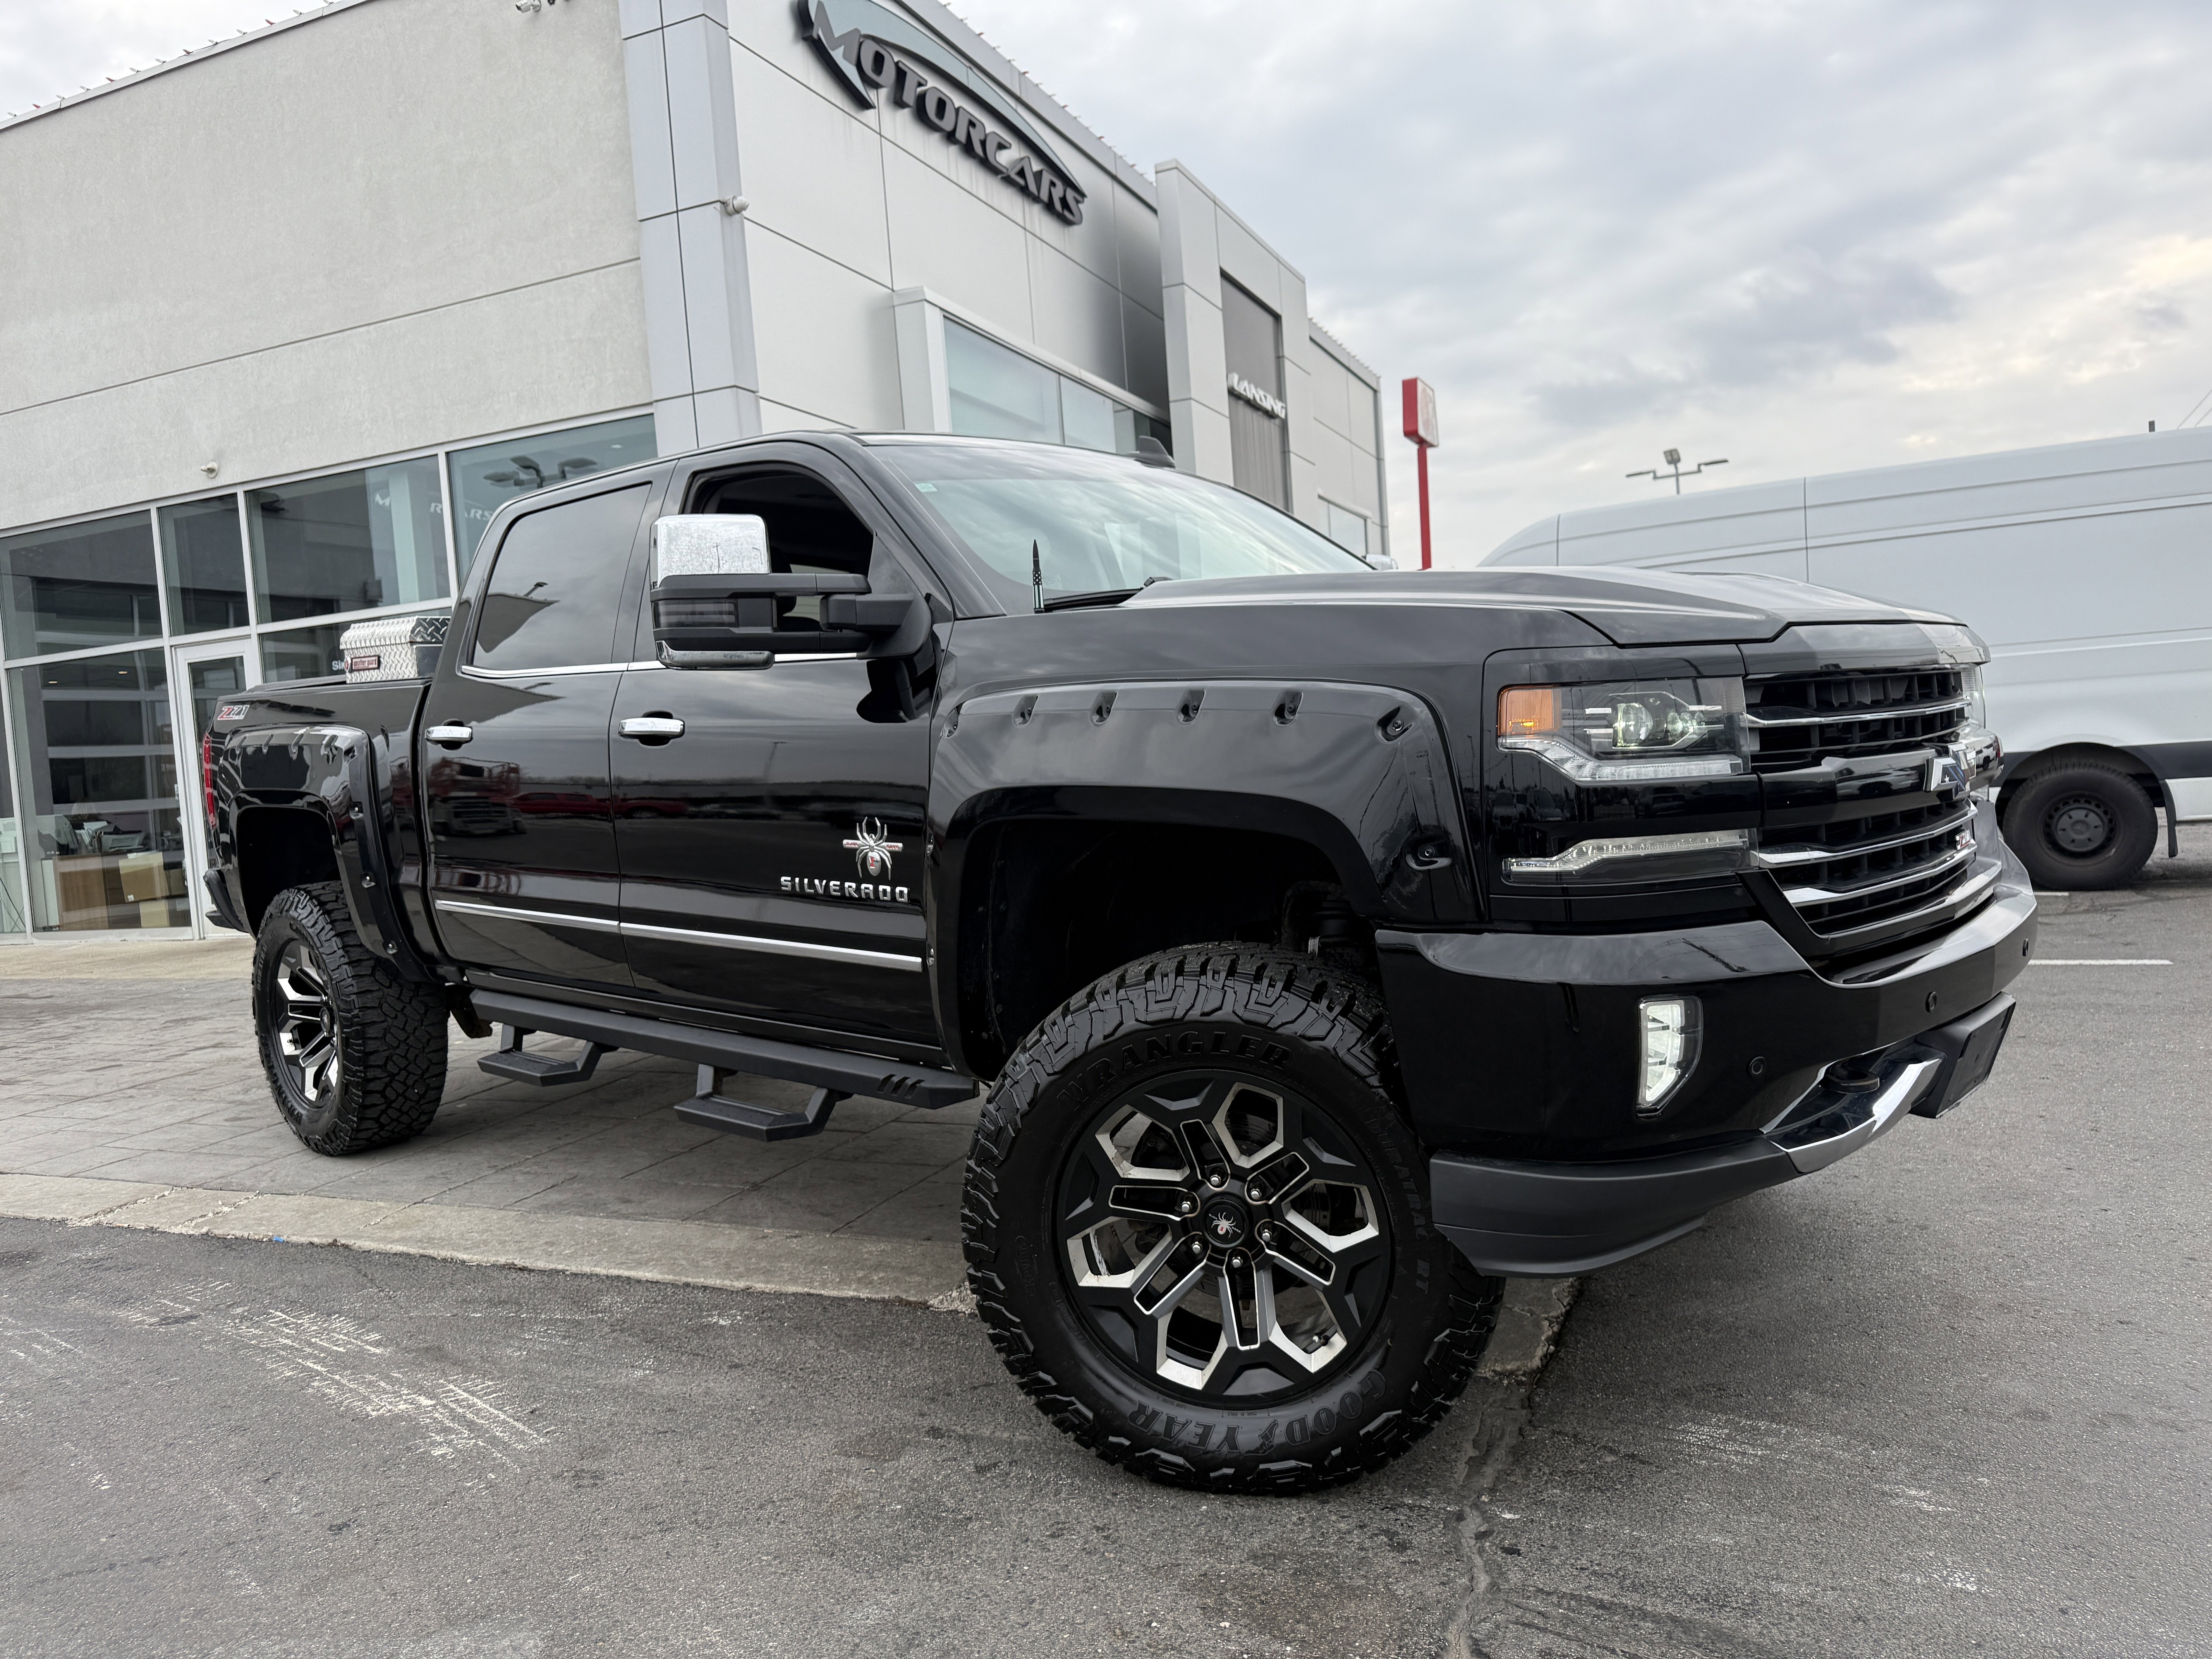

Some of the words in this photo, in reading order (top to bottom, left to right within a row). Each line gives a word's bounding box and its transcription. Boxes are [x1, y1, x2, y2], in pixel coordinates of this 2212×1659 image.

[812, 0, 1085, 225] MOTORCARS
[1228, 373, 1286, 419] LANSING
[217, 704, 250, 721] Z71
[780, 876, 909, 902] SILVERADO
[1056, 1030, 1294, 1113] WRANGLER
